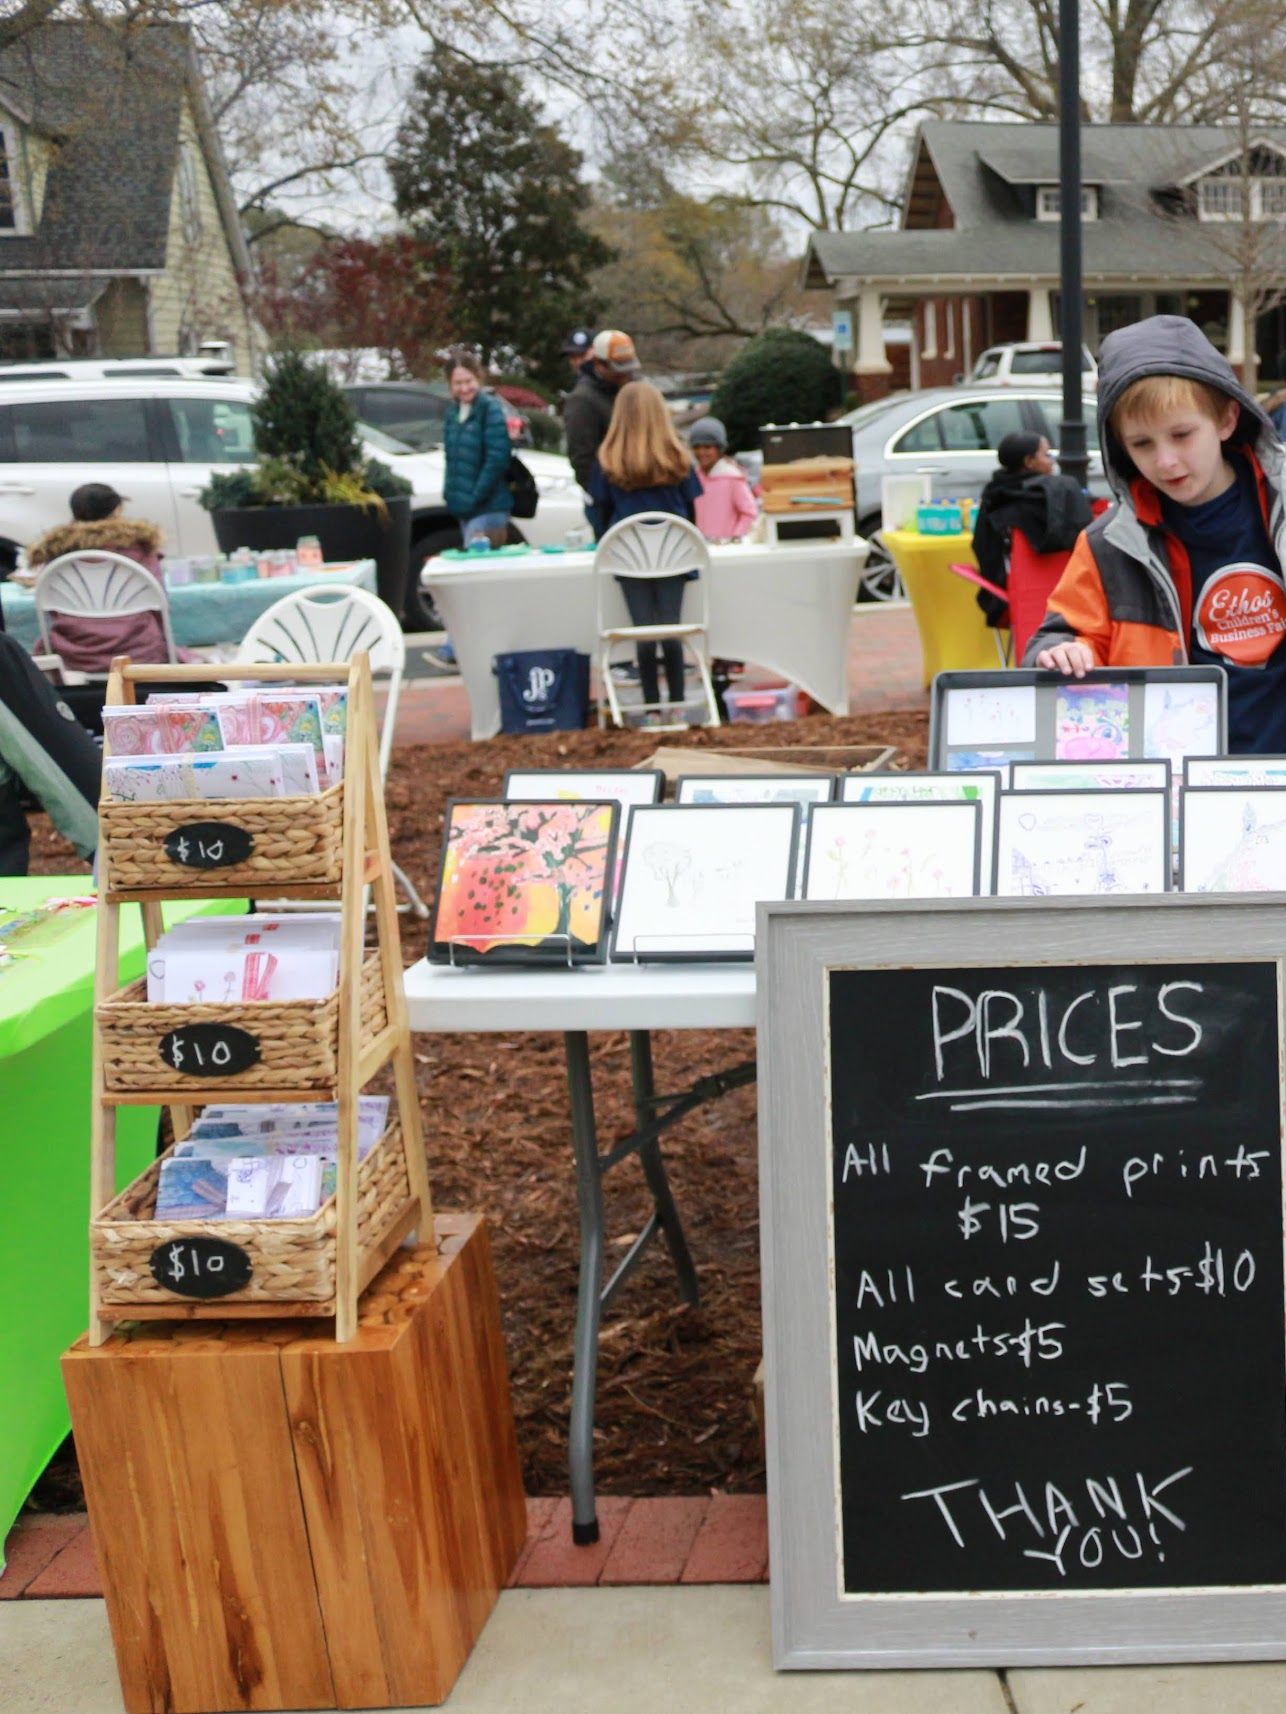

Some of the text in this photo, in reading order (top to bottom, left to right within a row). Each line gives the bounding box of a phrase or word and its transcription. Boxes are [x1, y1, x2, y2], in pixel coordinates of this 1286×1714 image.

[1208, 587, 1274, 622] Ethos
[1210, 626, 1266, 643] Business
[171, 1034, 232, 1068] $10
[932, 981, 1204, 1082] PRICES
[842, 1143, 1271, 1198] All framed prints
[957, 1196, 1040, 1244] $15
[168, 1244, 225, 1283] $10
[856, 1264, 915, 1309] All
[856, 1389, 930, 1437] Key
[900, 1466, 1194, 1548] THANK
[1023, 1522, 1166, 1577] YOU!
